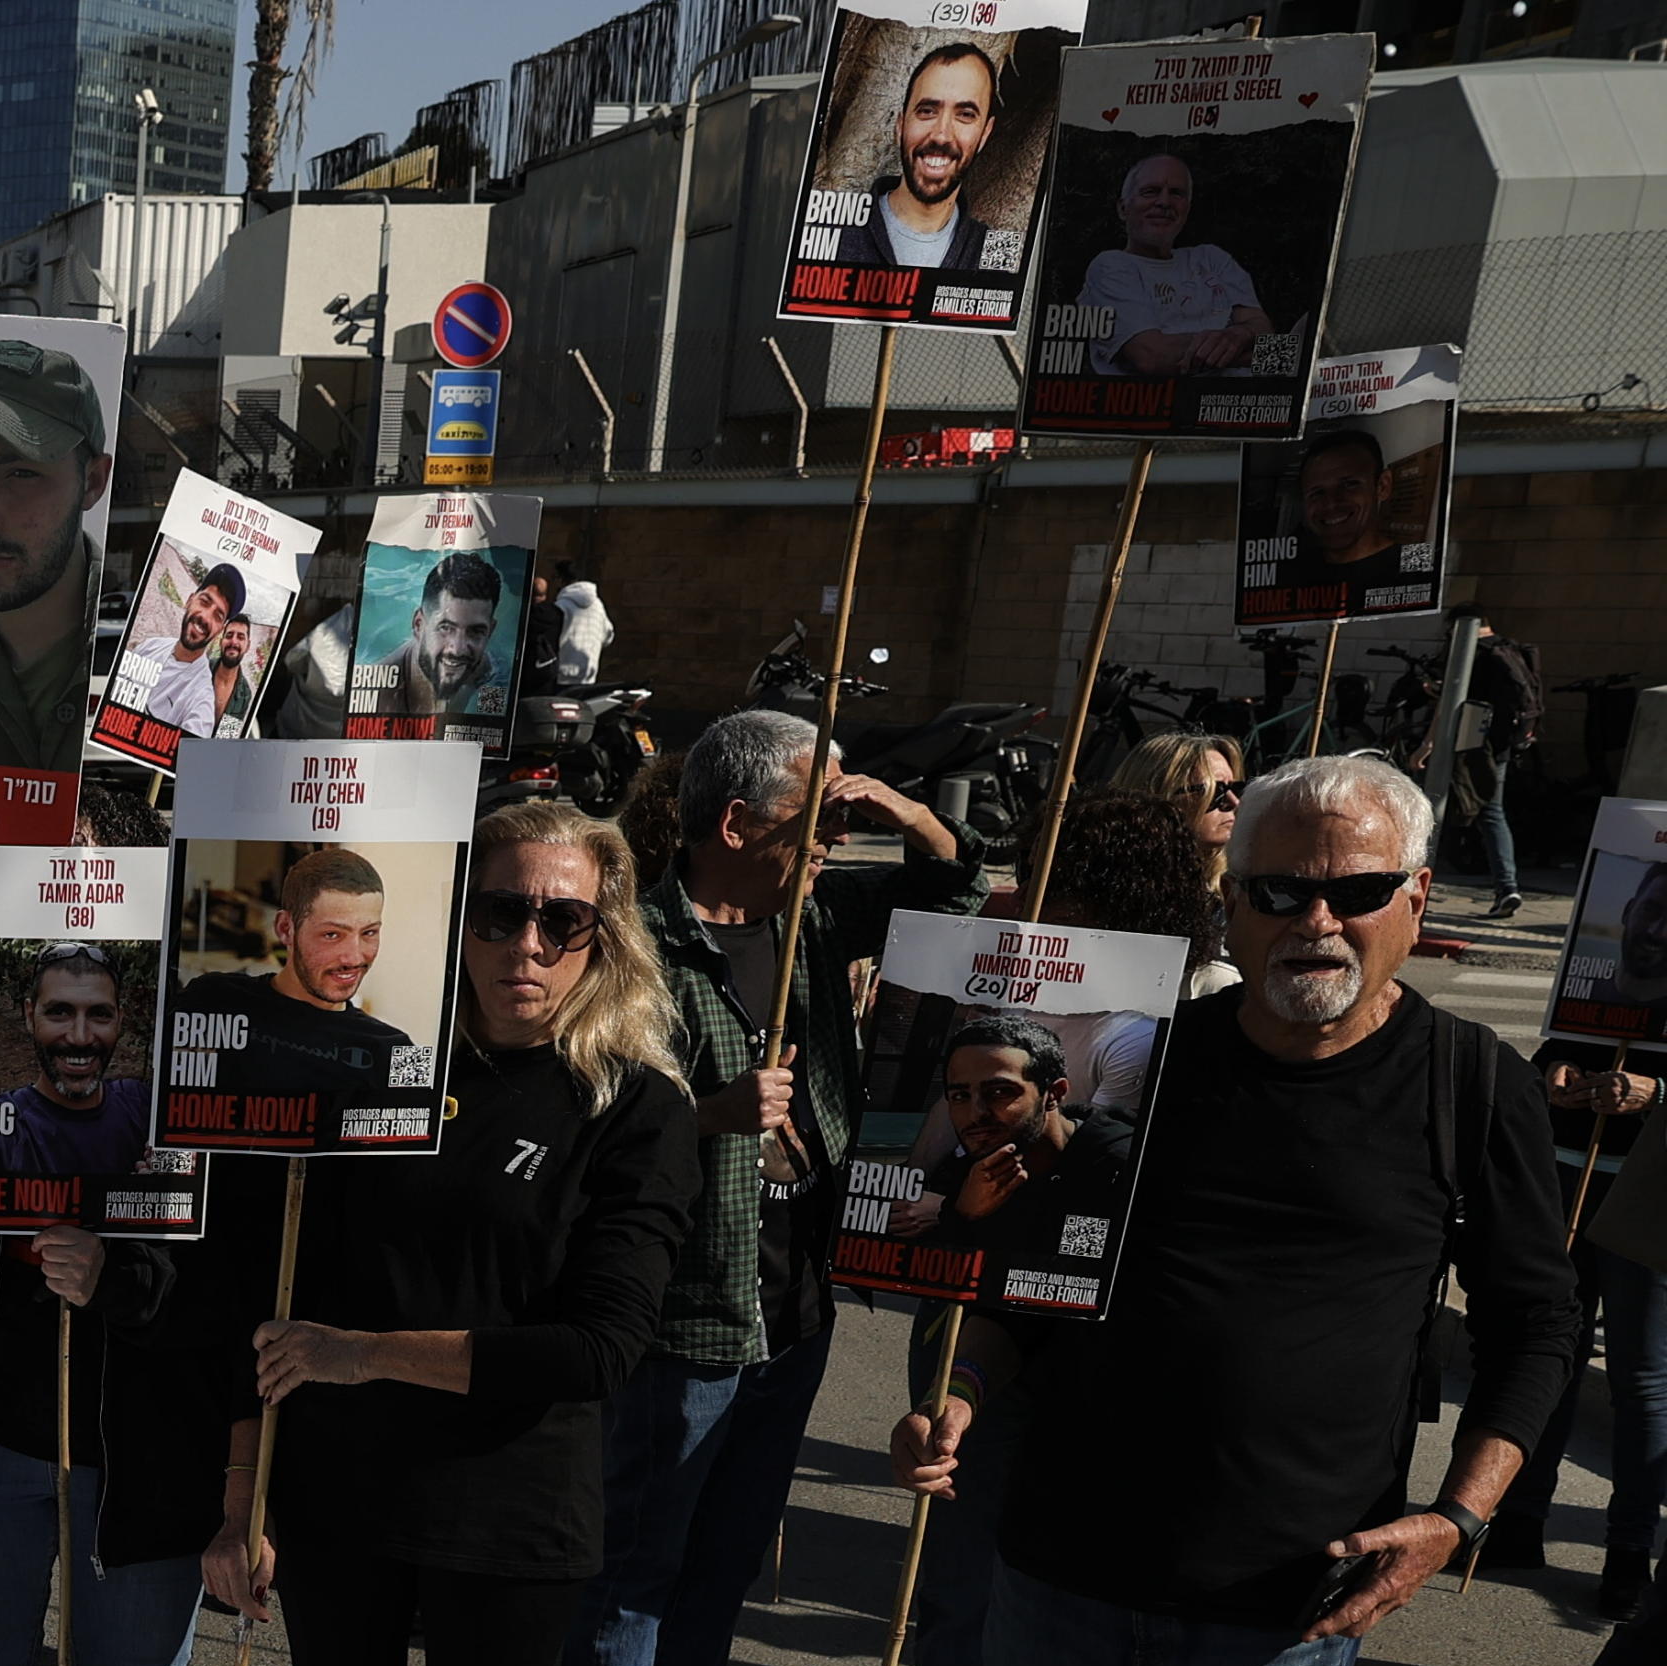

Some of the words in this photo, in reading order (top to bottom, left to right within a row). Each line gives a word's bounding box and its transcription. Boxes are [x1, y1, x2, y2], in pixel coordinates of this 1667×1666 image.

[1126, 84, 1166, 105] KEITH
[1170, 82, 1231, 103] SAMUEL
[1234, 79, 1282, 100] SIEGEL
[805, 190, 872, 226] BRING
[798, 227, 841, 261] HIM
[429, 464, 453, 474] 05:00
[201, 508, 221, 528] GALI
[219, 517, 239, 535] AND
[425, 514, 440, 528] ZIV
[303, 758, 320, 780] חן
[325, 758, 358, 779] איתי
[290, 782, 323, 804] ITAY
[327, 782, 364, 805] CHEN
[311, 807, 340, 832] (19)
[50, 859, 76, 880] אדר
[82, 859, 115, 880] תמיר
[38, 882, 82, 904] TAMIR
[84, 882, 124, 905] ADAR
[65, 906, 94, 929] (38)
[972, 953, 1032, 977] NIMROD
[1035, 958, 1085, 984] COHEN
[504, 1139, 538, 1174] 7
[524, 1146, 549, 1180] OCTOBER
